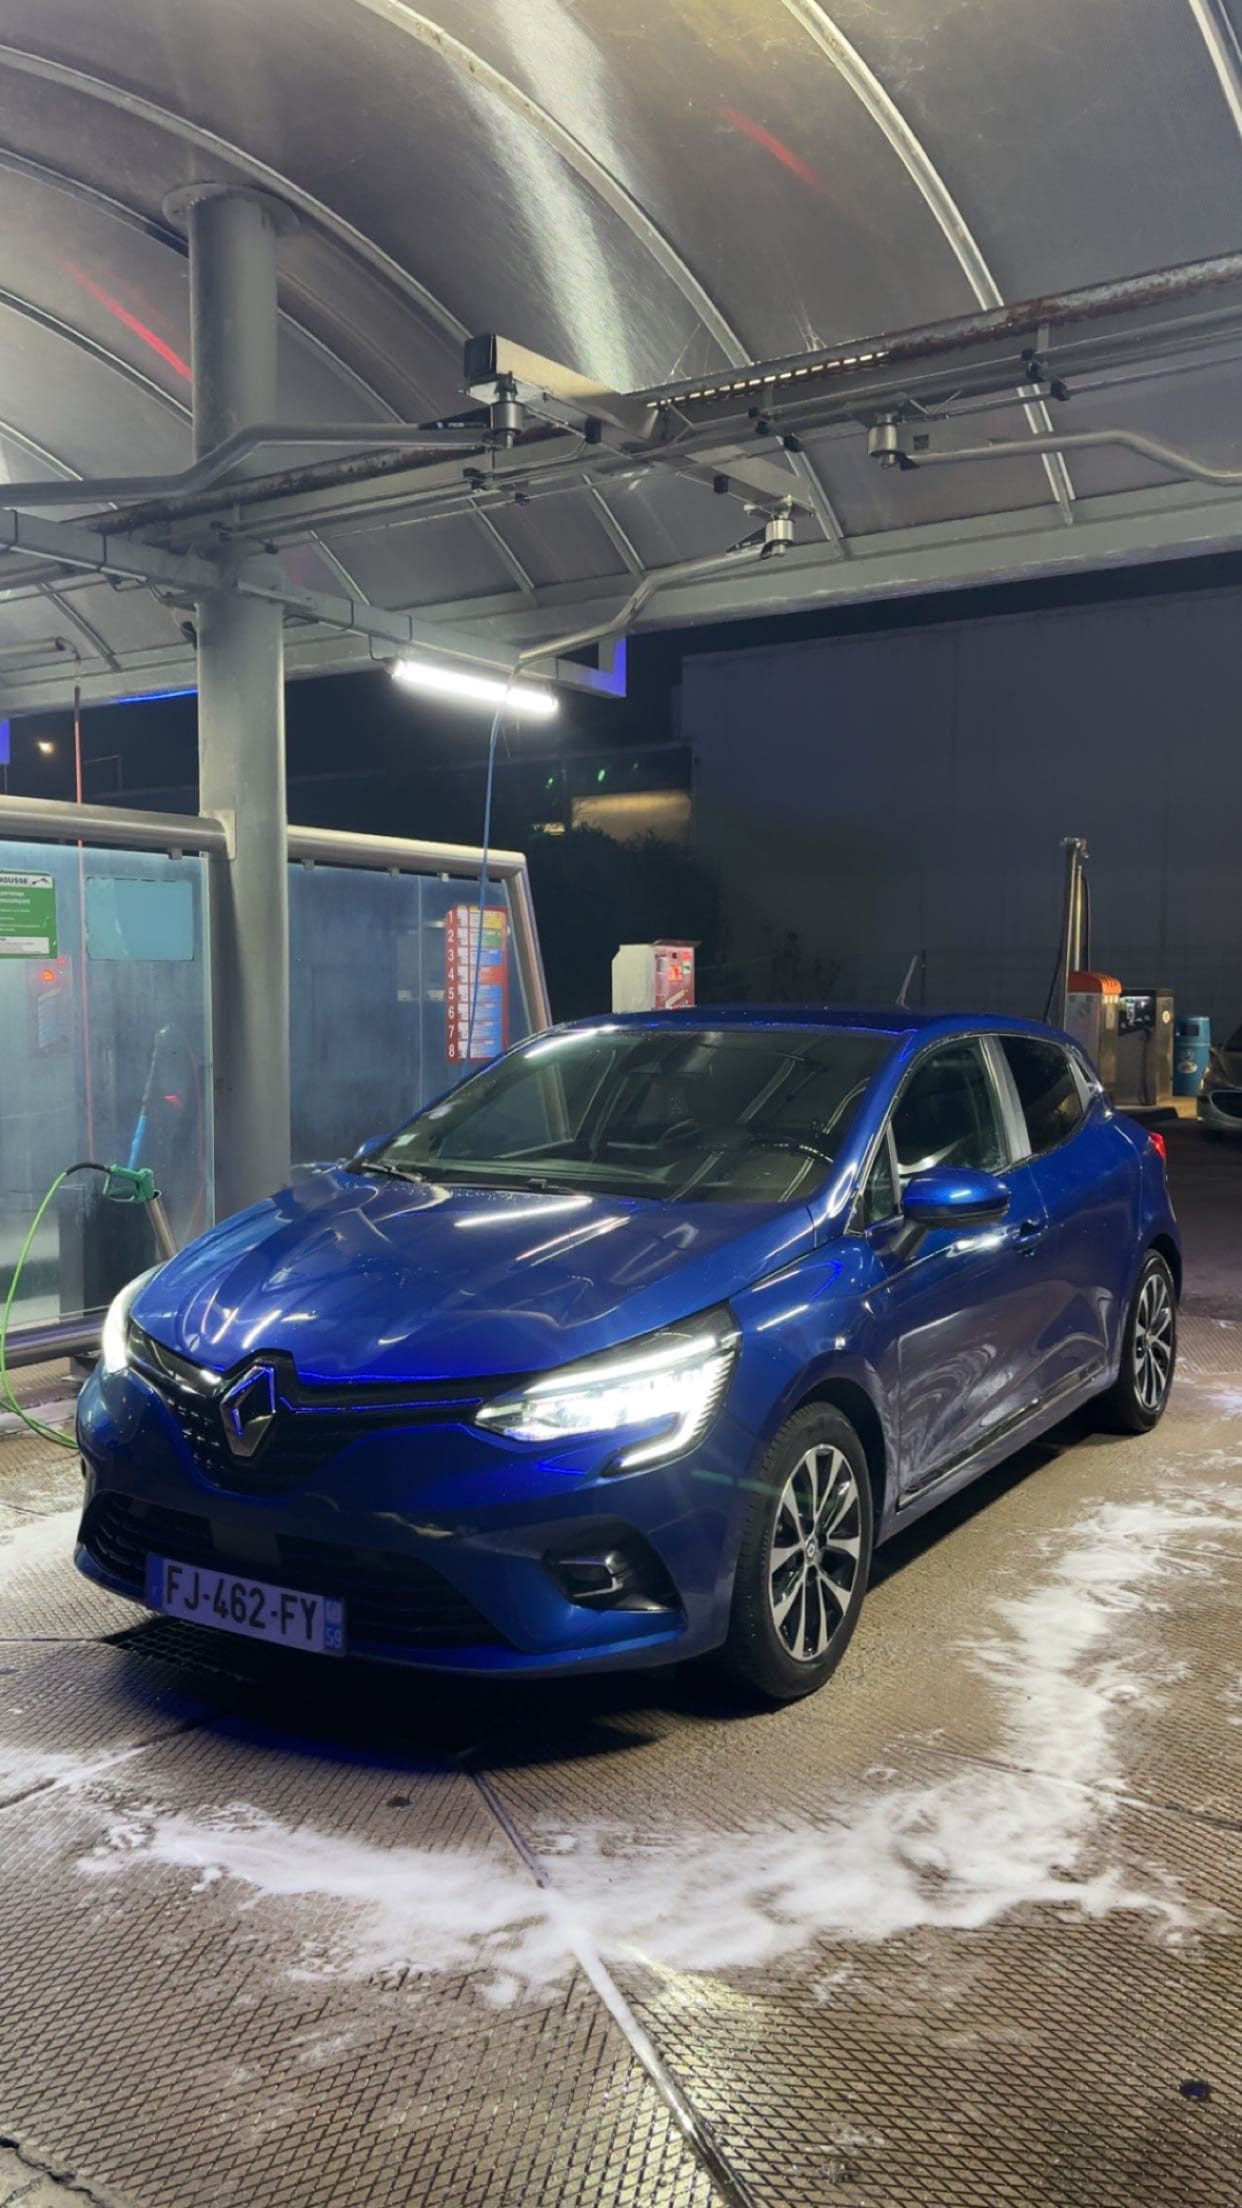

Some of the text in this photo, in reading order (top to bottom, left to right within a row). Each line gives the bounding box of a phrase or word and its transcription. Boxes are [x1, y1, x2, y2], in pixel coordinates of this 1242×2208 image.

[447, 910, 453, 923] 1
[447, 929, 454, 943] 2
[447, 949, 454, 962] 3
[447, 967, 454, 981] 4
[447, 987, 455, 1000] 5
[448, 1006, 455, 1019] 6
[448, 1025, 455, 1038] 7
[448, 1044, 455, 1057] 8
[167, 1565, 318, 1640] FJ-462-FY
